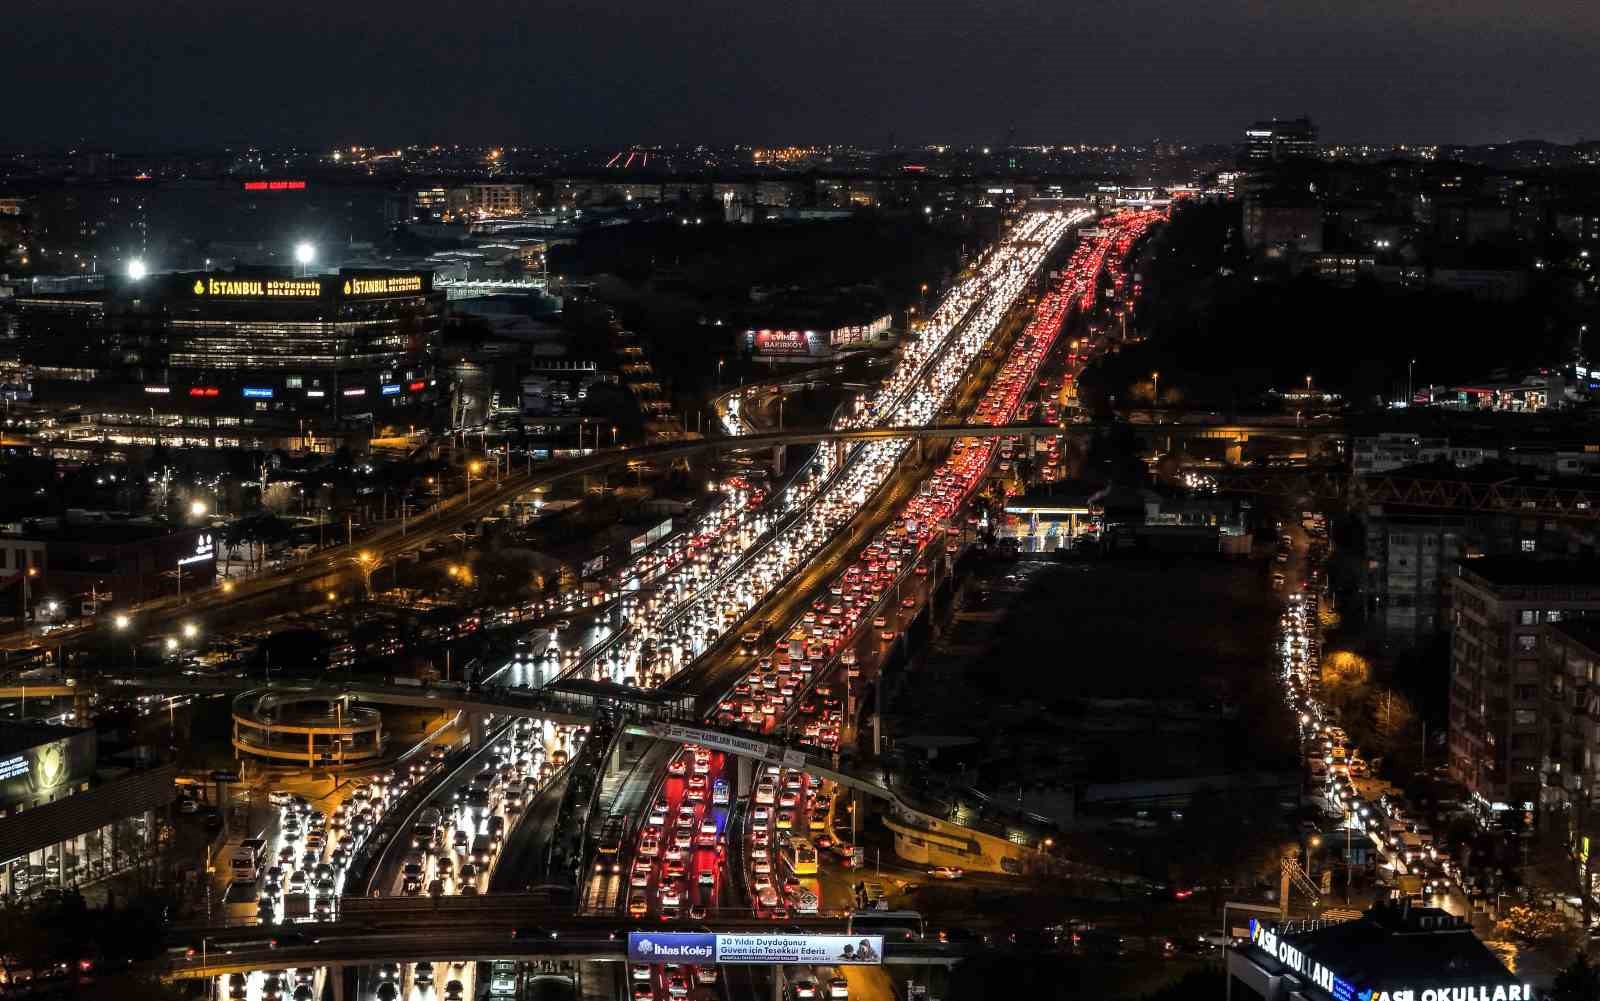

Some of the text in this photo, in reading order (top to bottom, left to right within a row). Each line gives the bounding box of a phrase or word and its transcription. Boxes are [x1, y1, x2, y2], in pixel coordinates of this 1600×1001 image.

[209, 278, 264, 295] İSTANBUL
[353, 278, 388, 294] İSTANBUL
[654, 943, 680, 955] İhlas
[681, 945, 713, 958] Koleji
[720, 946, 747, 954] Güven
[801, 947, 826, 955] Ederiz
[721, 938, 807, 947] 30 Yıldır Duyduğunuz
[1279, 941, 1334, 993] OKULLARI
[1421, 984, 1531, 1001] OKULLARI
